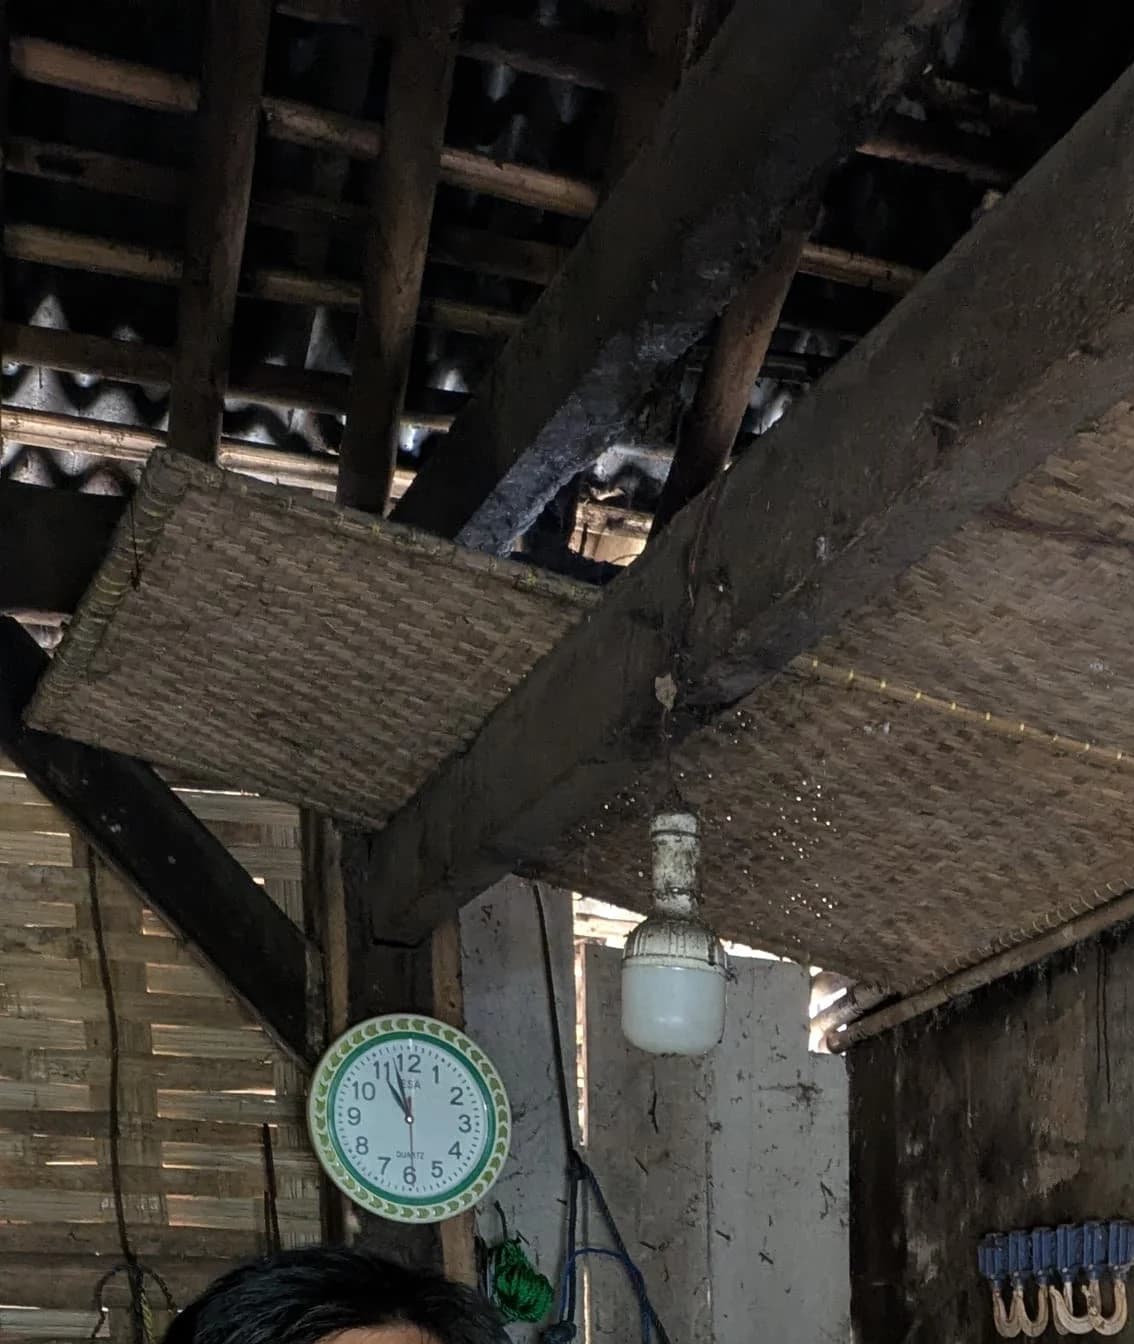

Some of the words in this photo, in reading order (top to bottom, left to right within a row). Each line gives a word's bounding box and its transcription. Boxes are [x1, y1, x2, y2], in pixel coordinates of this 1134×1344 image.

[374, 1061, 390, 1081] 11
[397, 1053, 421, 1073] 12
[432, 1065, 439, 1084] 1
[352, 1081, 376, 1101] 10
[450, 1087, 464, 1106] 2
[348, 1107, 361, 1126] 9
[459, 1114, 471, 1133] 3
[356, 1136, 368, 1155] 8
[448, 1141, 462, 1159] 4
[396, 1151, 425, 1160] QUARTZ
[378, 1157, 391, 1175] 7
[403, 1166, 416, 1185] 6
[431, 1161, 443, 1178] 5
